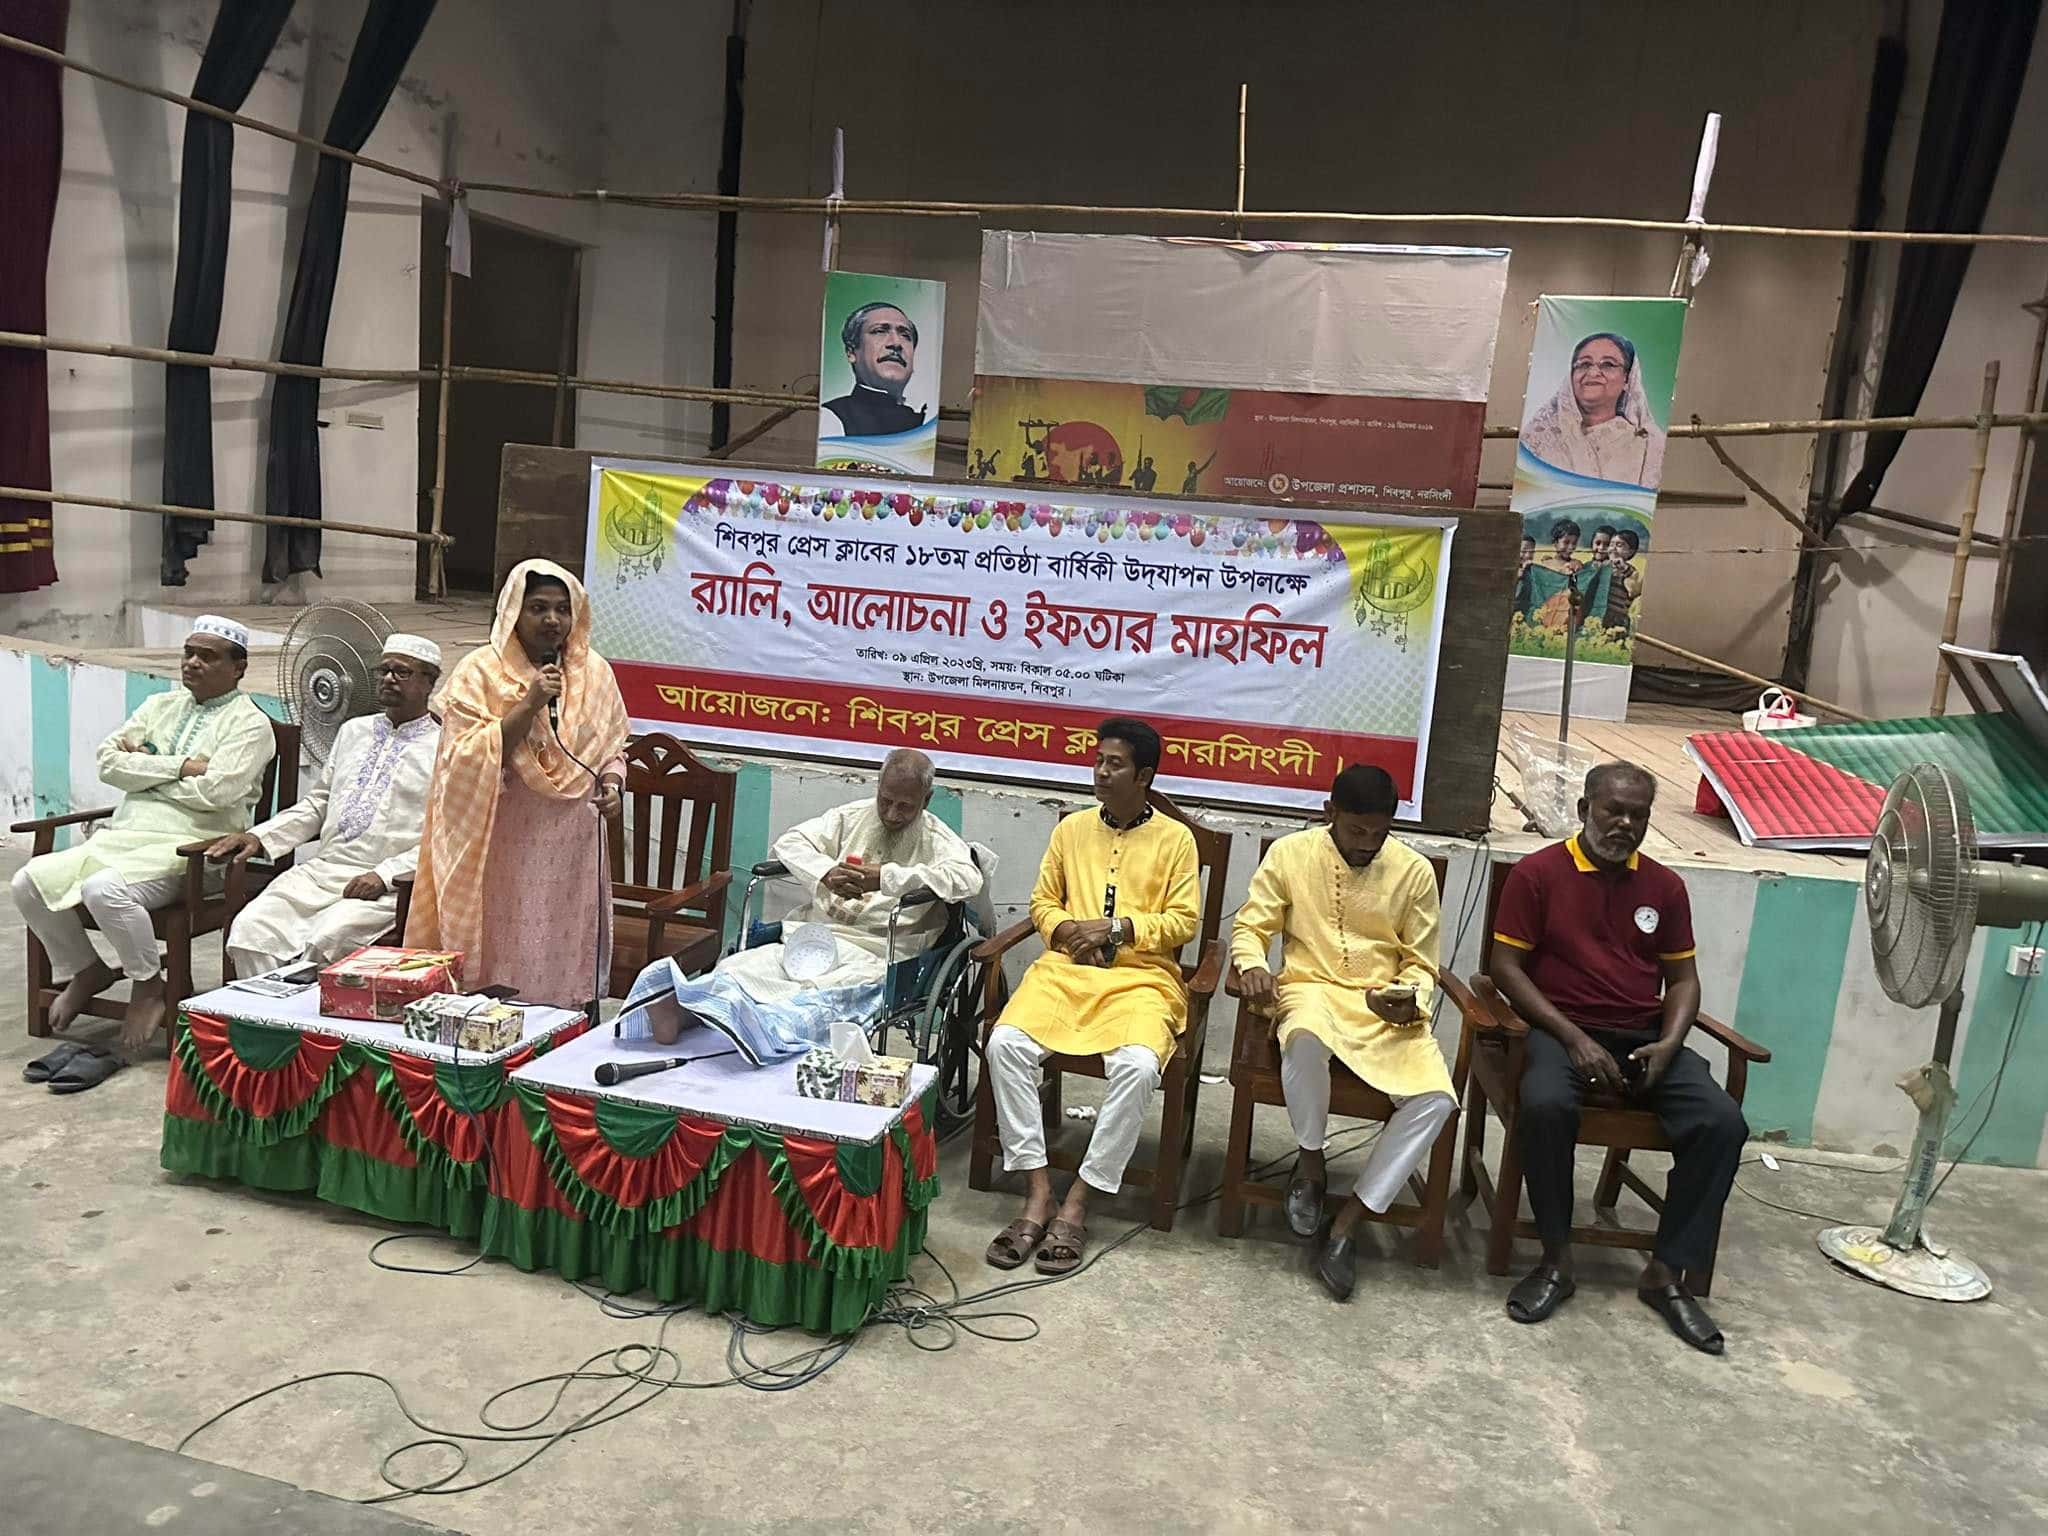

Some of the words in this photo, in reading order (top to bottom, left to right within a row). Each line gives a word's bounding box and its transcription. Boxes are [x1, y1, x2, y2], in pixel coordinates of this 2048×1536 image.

[1291, 478, 1335, 493] উপজেলা
[1338, 481, 1379, 498] প্রশাসন,
[714, 522, 782, 559] শিবপুর
[787, 534, 830, 558] প্রেস
[835, 538, 898, 564] ক্লাবের
[905, 545, 970, 570] ১৮তম
[974, 545, 1041, 576] প্রতিষ্ঠা
[1047, 551, 1118, 582] বার্ষিকী
[1219, 562, 1312, 598] উপলক্ষে
[807, 583, 972, 637] আলোচনা
[982, 599, 1008, 641] ও
[1024, 590, 1157, 653] ইফতার
[1170, 603, 1329, 669] মাহফিল
[892, 652, 908, 663] ০৯
[911, 651, 939, 665] এপ্রিল
[1021, 661, 1052, 676] বিকাল
[1055, 668, 1090, 680] ০৫.০০
[1094, 668, 1126, 684] ঘটিকা
[928, 671, 970, 688] উপজেলা
[972, 675, 1027, 694] মিলনায়তন,
[845, 696, 966, 744] শিবপুর
[974, 717, 1056, 750] প্রেস
[1063, 726, 1099, 754] ক্ল
[1162, 733, 1323, 777] নরসিংদী
